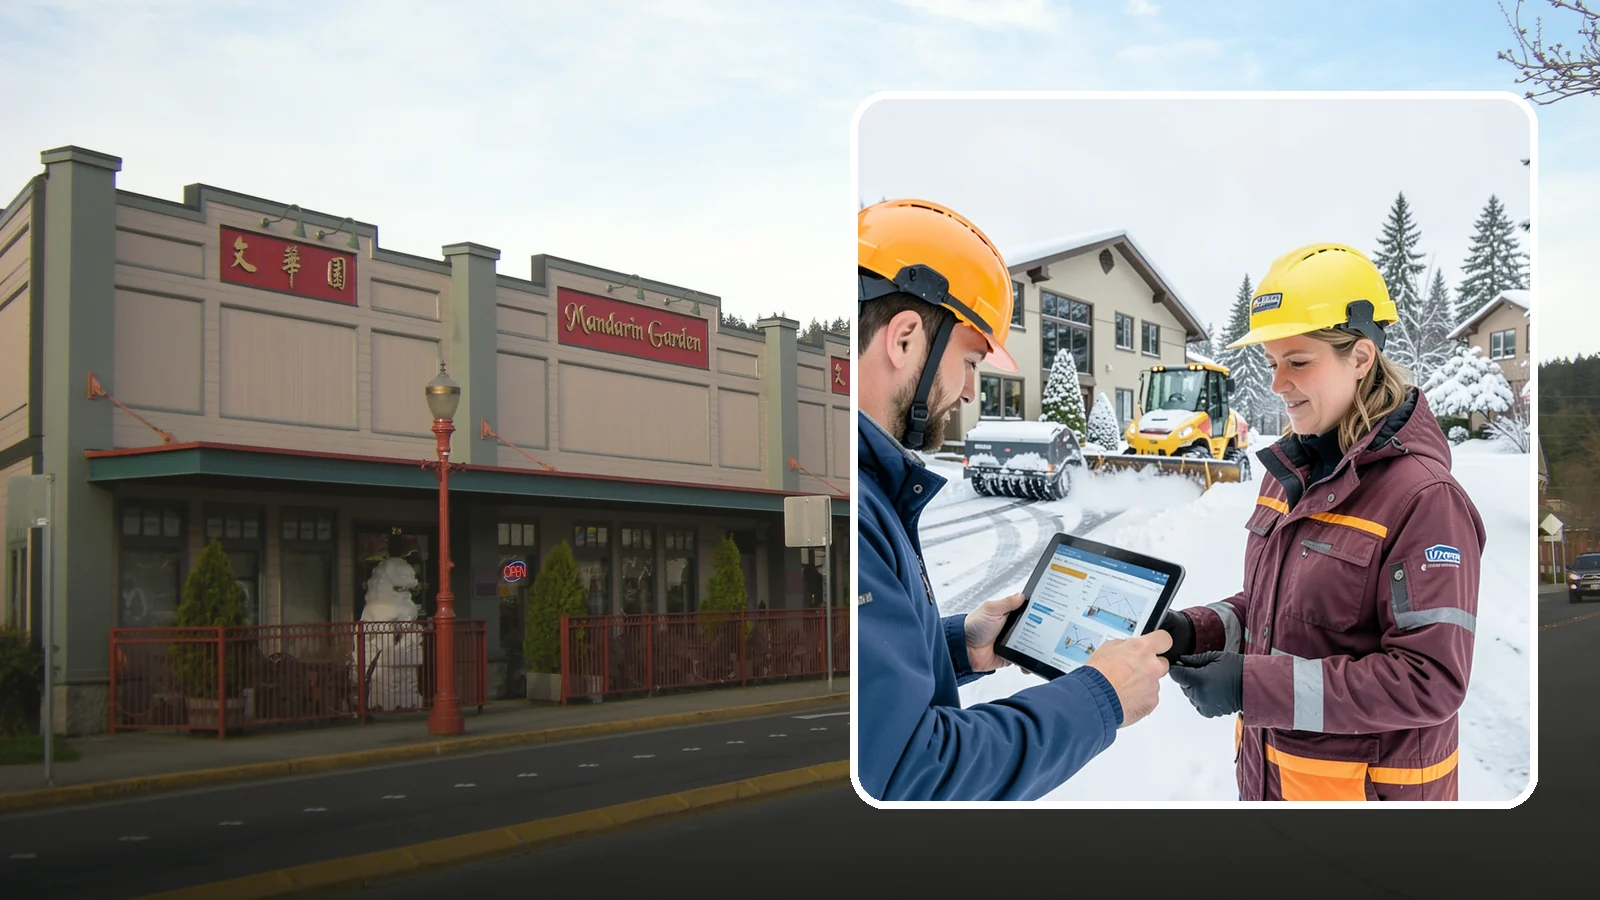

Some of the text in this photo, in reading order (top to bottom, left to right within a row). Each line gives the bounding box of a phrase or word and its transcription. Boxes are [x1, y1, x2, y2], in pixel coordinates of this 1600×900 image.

[231, 235, 346, 291] 文華園
[564, 302, 701, 352] Mandarin Garden
[503, 565, 527, 578] OPEN
